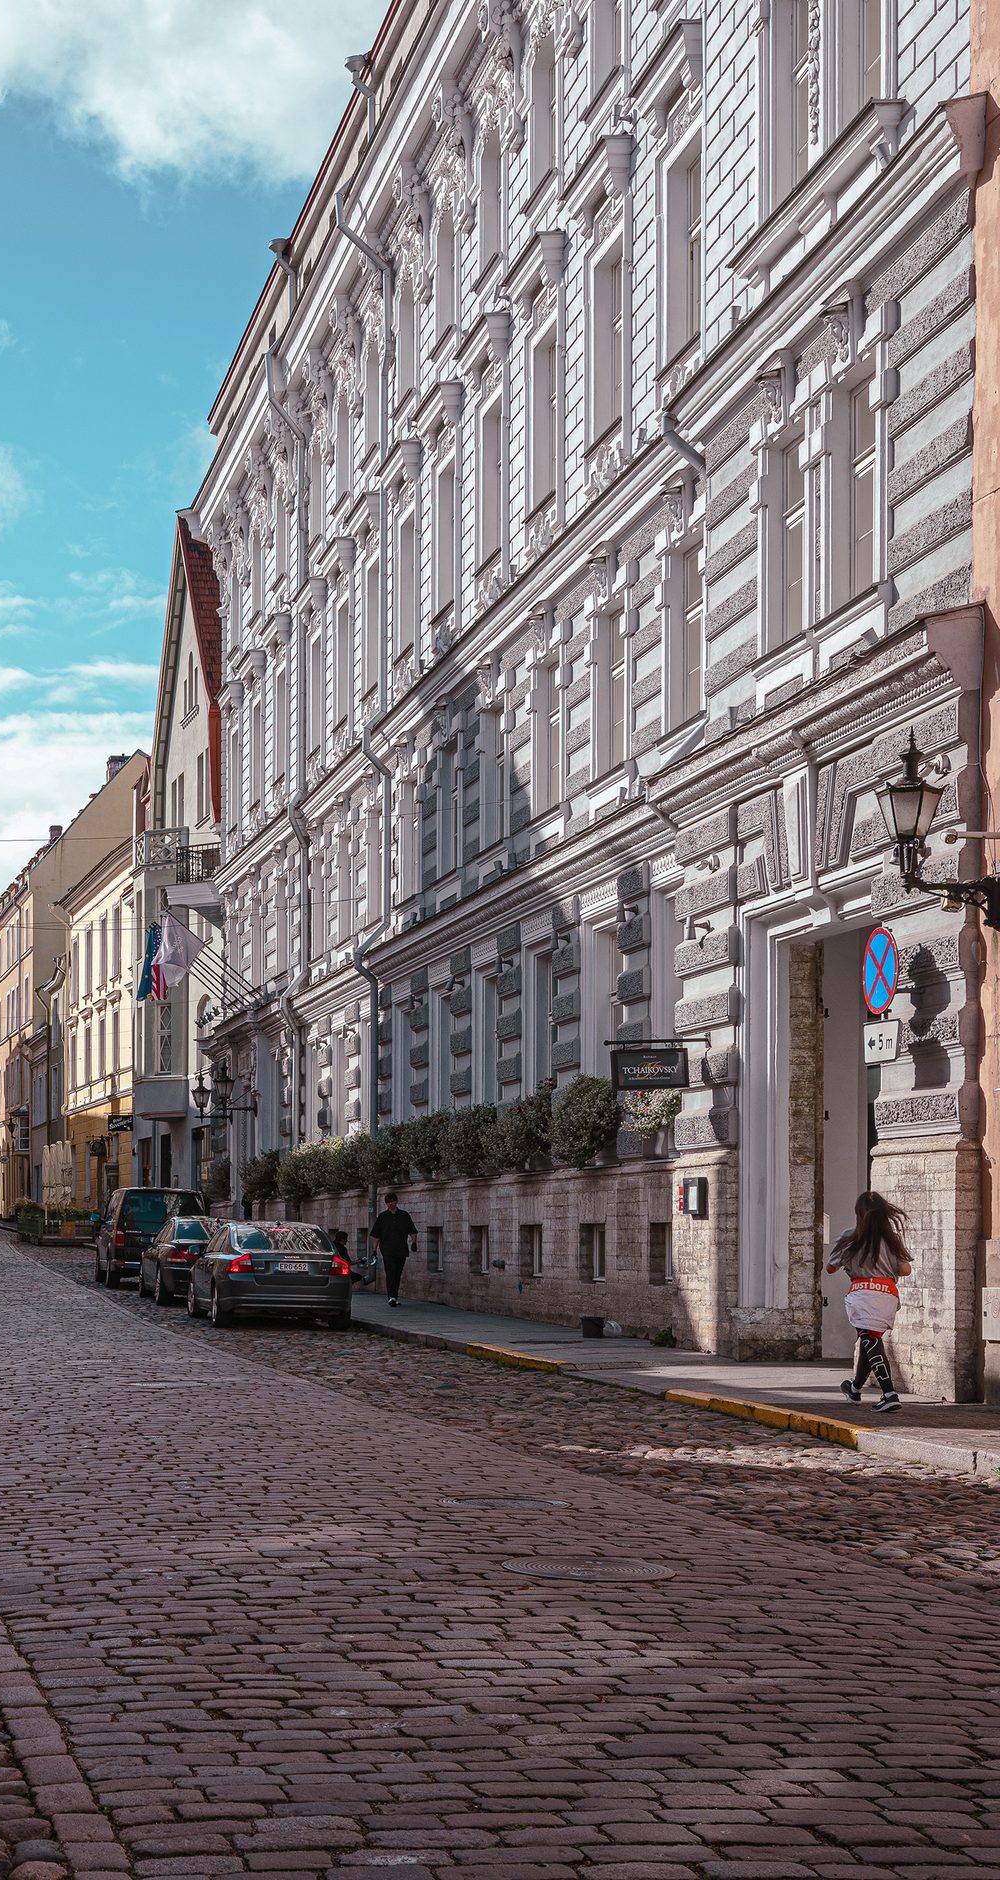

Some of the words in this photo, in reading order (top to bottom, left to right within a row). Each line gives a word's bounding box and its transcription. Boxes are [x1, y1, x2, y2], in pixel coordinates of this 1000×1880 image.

[878, 1033, 884, 1051] 5
[885, 1038, 893, 1050] m
[622, 1065, 678, 1075] TCHAIKOVSKY
[851, 1281, 869, 1291] JUST
[869, 1282, 881, 1290] DO
